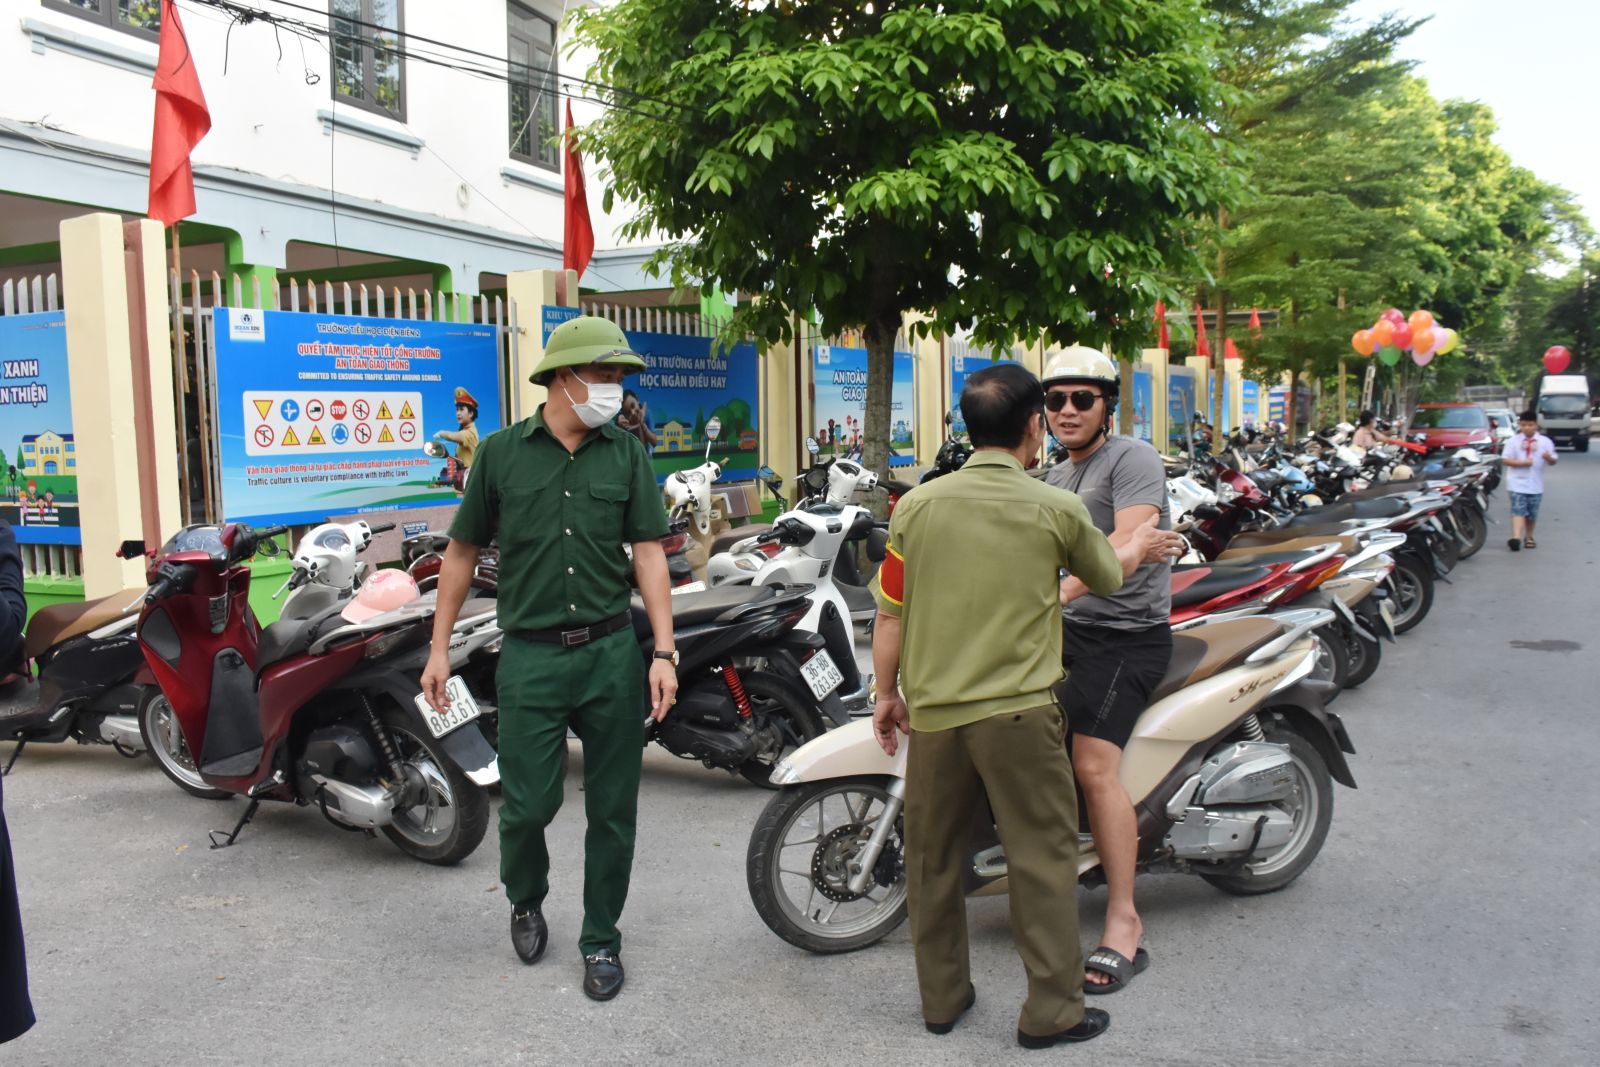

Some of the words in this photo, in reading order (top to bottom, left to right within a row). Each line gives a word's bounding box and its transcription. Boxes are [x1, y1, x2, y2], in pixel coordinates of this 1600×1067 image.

[546, 310, 562, 320] KHU
[367, 325, 381, 338] HỌC
[298, 341, 322, 356] QUYẾT
[324, 342, 340, 356] TÂM
[342, 344, 360, 358] THỰC
[362, 344, 379, 358] HIỆN
[381, 344, 393, 358] TỐT
[415, 345, 441, 359] TRƯỜNG
[4, 360, 39, 378] XANH
[335, 358, 346, 369] AN
[348, 357, 367, 370] TOÀN
[369, 359, 385, 371] GIAO
[387, 358, 410, 371] THÔNG
[659, 354, 693, 370] TRƯỜNG
[694, 358, 705, 370] AN
[708, 357, 727, 371] TOÀN
[298, 372, 330, 380] COMMITTED
[330, 372, 337, 380] TO
[364, 373, 384, 381] TRAFFIC
[384, 373, 402, 381] SAFETY
[640, 374, 659, 390] HỌC
[661, 373, 687, 388] NGÀN
[688, 374, 710, 388] ĐIỀU
[711, 377, 727, 388] HAY
[833, 371, 845, 384] AN
[847, 368, 867, 384] TOÀN
[11, 382, 47, 408] THIỆN
[842, 387, 863, 401] GIAO
[331, 405, 347, 415] STOP
[247, 477, 269, 486] Traffic
[269, 476, 292, 485] culture
[293, 475, 300, 483] is
[301, 474, 329, 483] voluntary
[330, 472, 364, 481] compliance
[365, 471, 378, 479] with
[378, 470, 395, 478] traffic
[396, 469, 409, 477] laws
[812, 666, 841, 698] 263.99
[430, 698, 476, 734] 883.61
